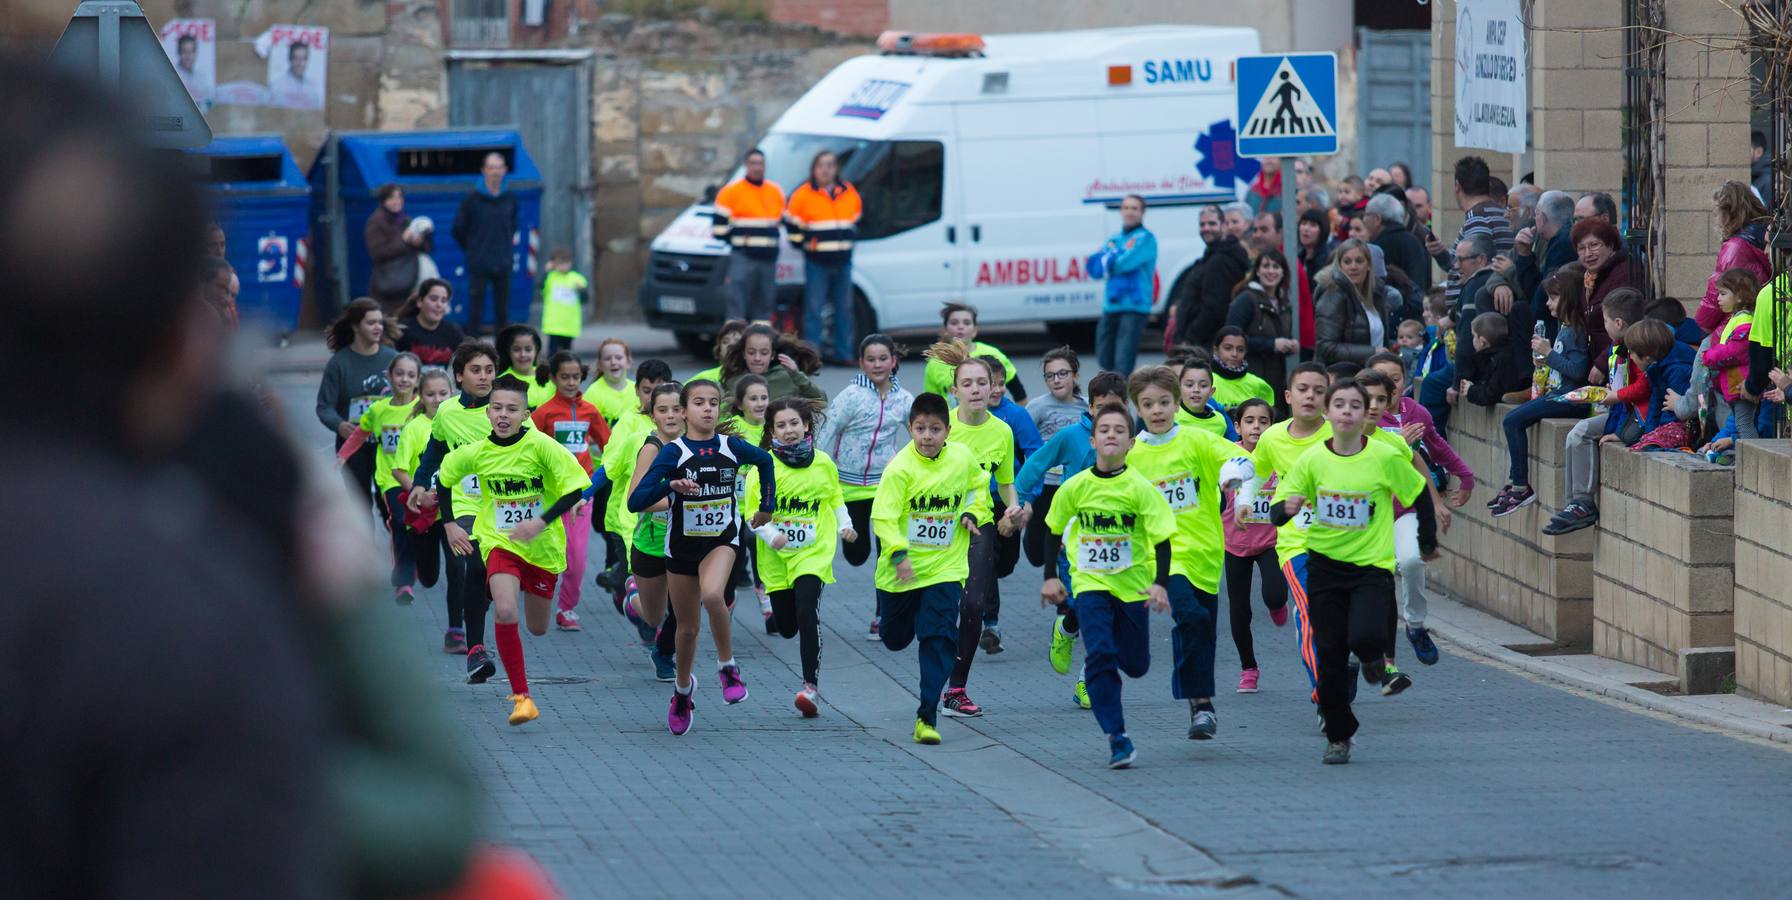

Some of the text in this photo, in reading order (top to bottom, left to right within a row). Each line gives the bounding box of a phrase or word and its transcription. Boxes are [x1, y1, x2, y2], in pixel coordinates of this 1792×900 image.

[1144, 59, 1211, 83] SAMU
[566, 431, 583, 444] 43
[504, 508, 533, 524] 234
[695, 511, 724, 527] 182
[1326, 503, 1356, 520] 181
[916, 524, 947, 539] 206
[1088, 547, 1120, 563] 248
